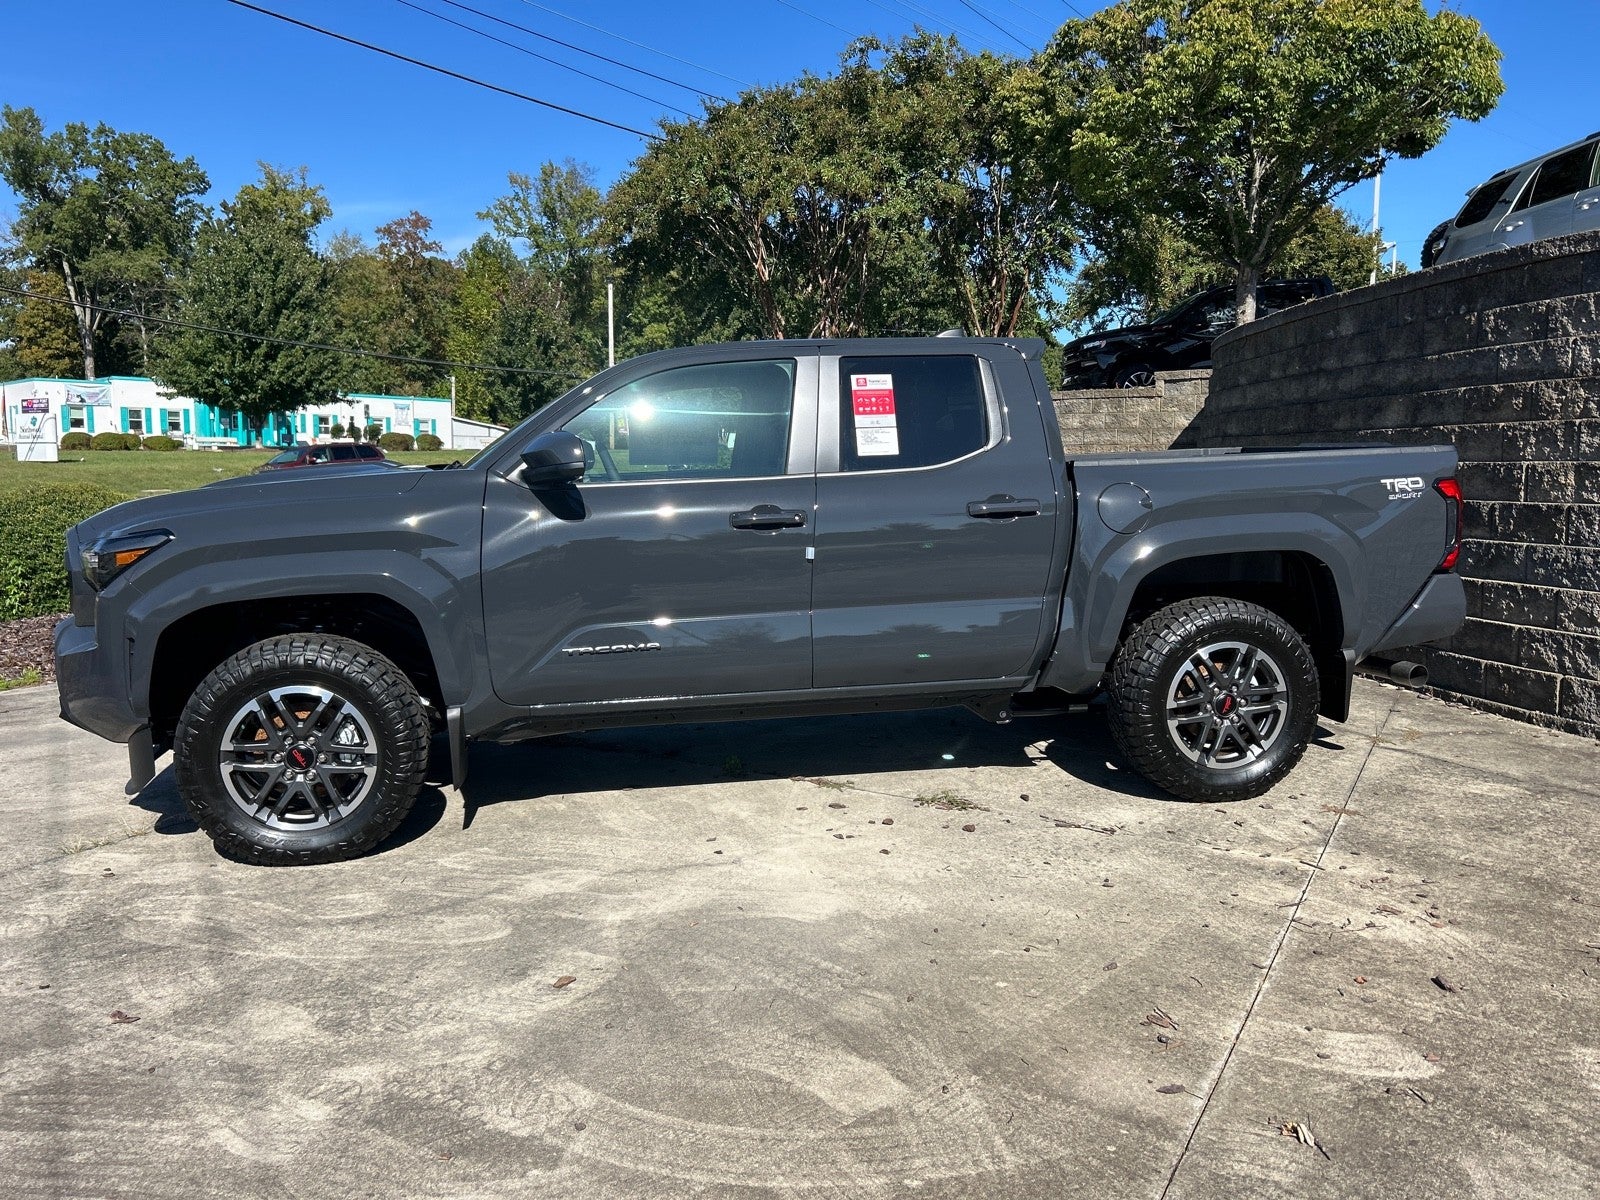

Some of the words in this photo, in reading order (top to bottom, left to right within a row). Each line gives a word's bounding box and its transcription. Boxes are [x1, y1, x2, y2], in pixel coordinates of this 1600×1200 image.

[1380, 476, 1425, 492] TRD
[1388, 491, 1423, 500] SPORT
[561, 642, 661, 656] TACOMA
